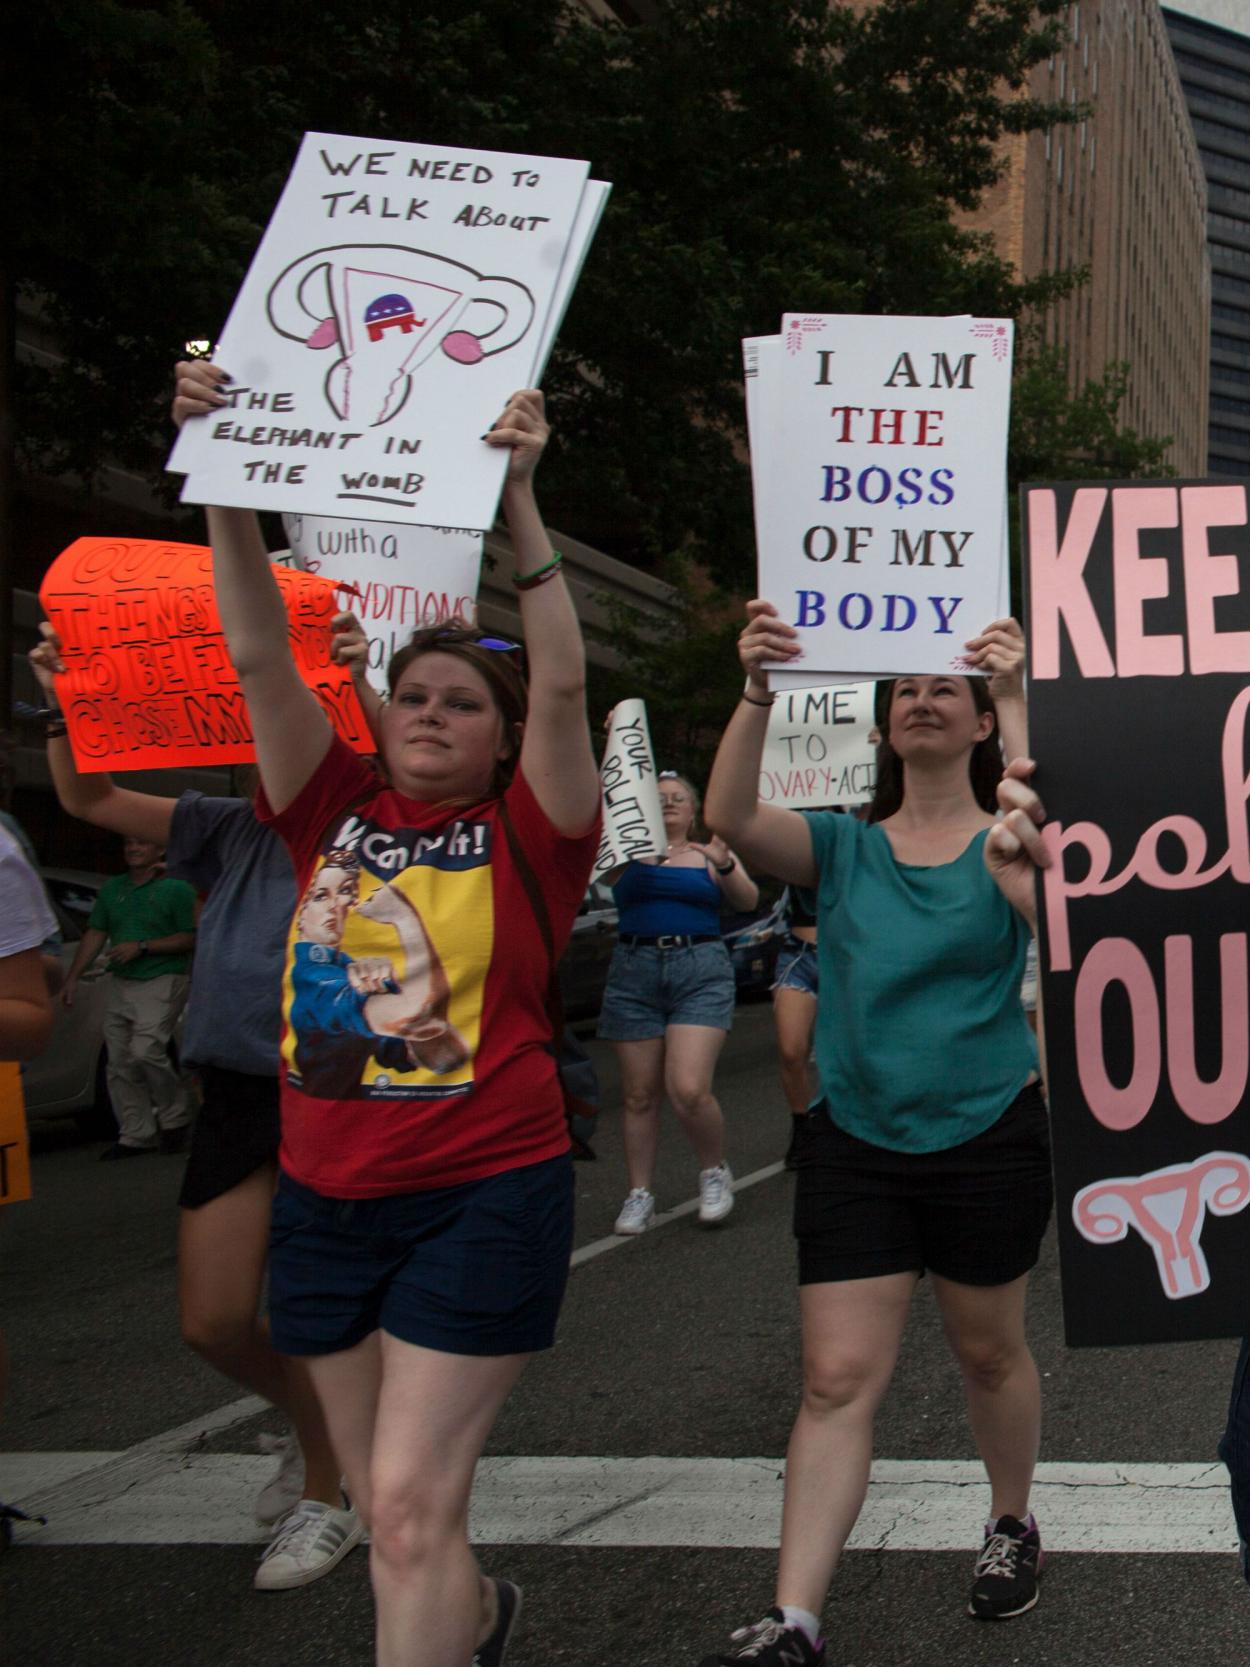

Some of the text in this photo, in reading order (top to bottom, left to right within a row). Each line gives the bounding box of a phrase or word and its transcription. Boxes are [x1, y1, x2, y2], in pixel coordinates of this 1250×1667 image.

[320, 149, 540, 188] WE NEED TO
[321, 190, 551, 232] TALK ABOUT
[814, 350, 976, 389] I AM
[225, 387, 296, 412] THE
[211, 421, 422, 454] ELEPHANT IN
[831, 406, 945, 447] THE
[244, 460, 307, 485] THE
[819, 464, 955, 508] BOSS
[317, 527, 375, 555] with
[381, 534, 398, 559] a
[803, 525, 974, 568] OF MY
[793, 590, 963, 635] BODY
[184, 691, 255, 748] MY
[776, 689, 858, 726] IME
[616, 717, 653, 780] YOUR
[778, 733, 827, 764] TO
[362, 832, 407, 869] Can
